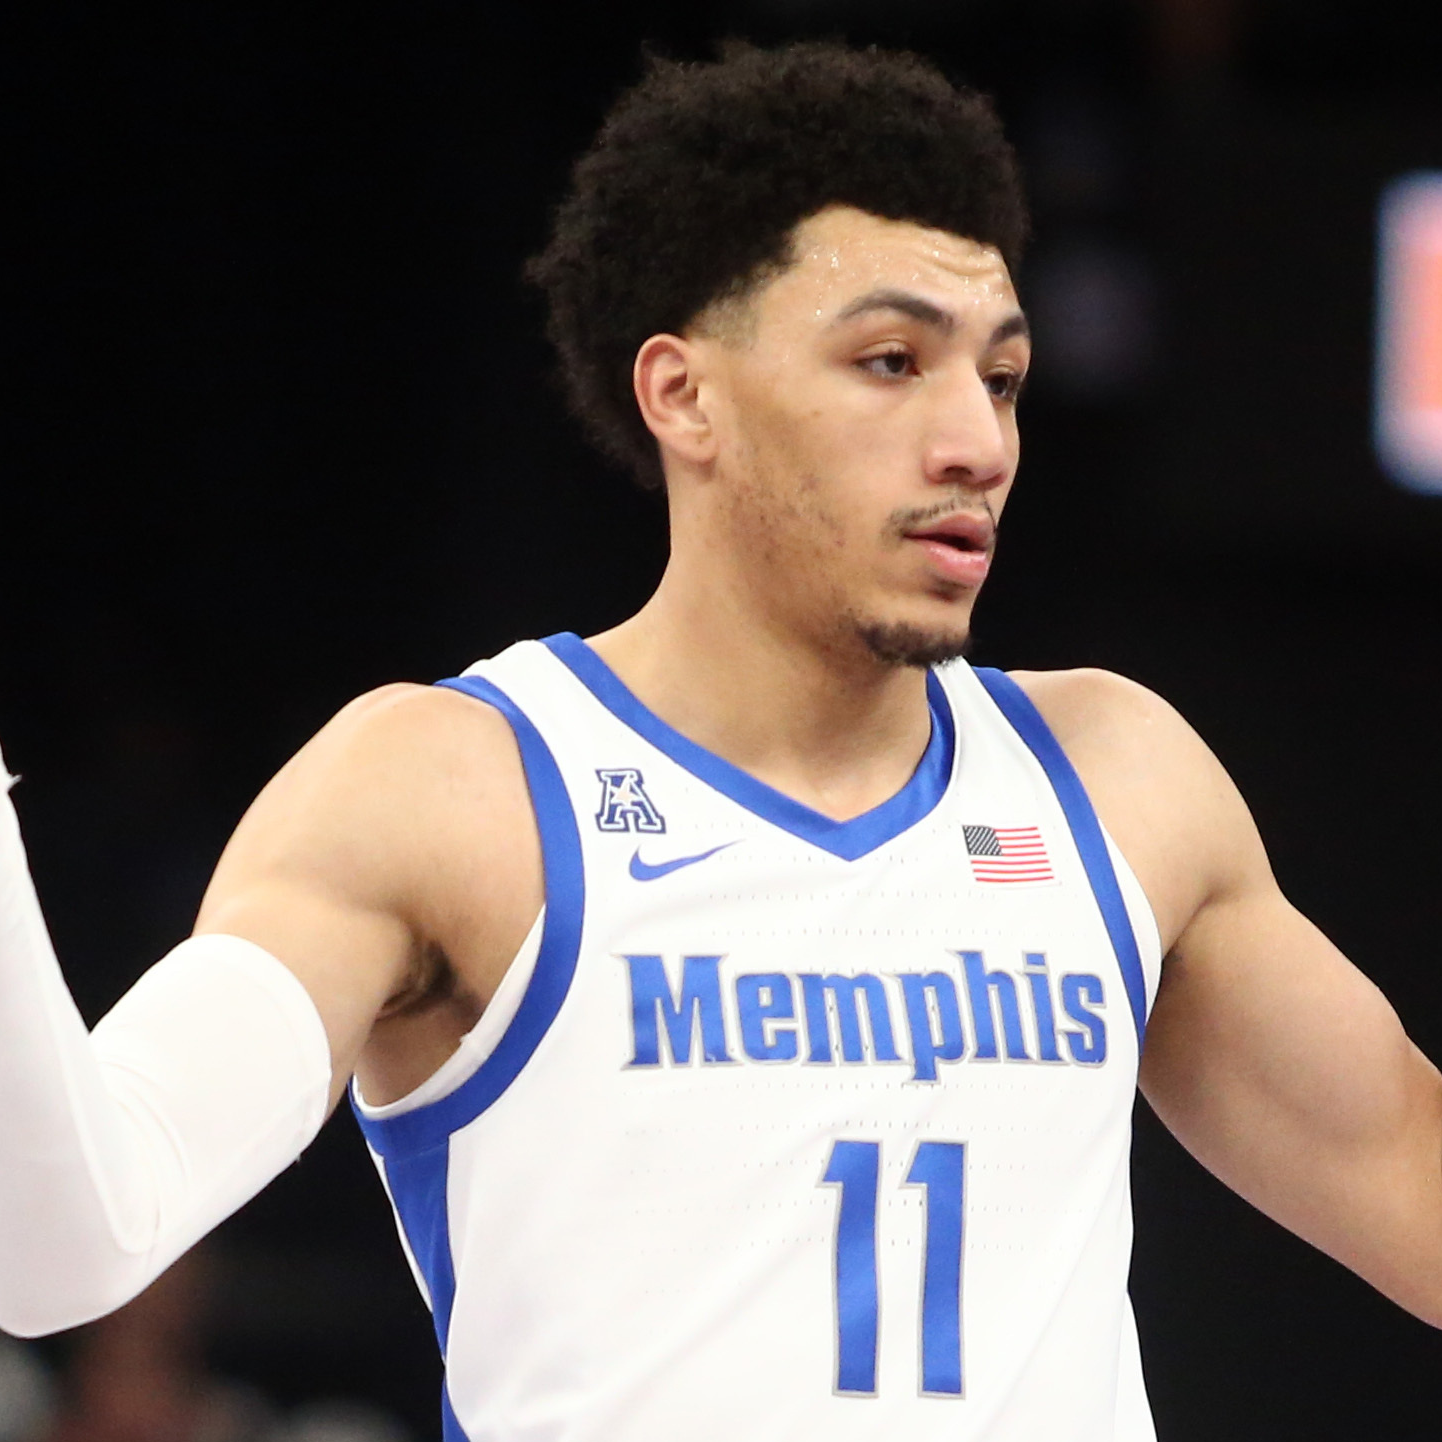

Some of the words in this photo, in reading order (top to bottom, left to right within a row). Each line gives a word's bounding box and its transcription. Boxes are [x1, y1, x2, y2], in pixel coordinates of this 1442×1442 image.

[595, 768, 666, 834] A
[614, 949, 1109, 1085] Memphis
[816, 1139, 969, 1399] 11
